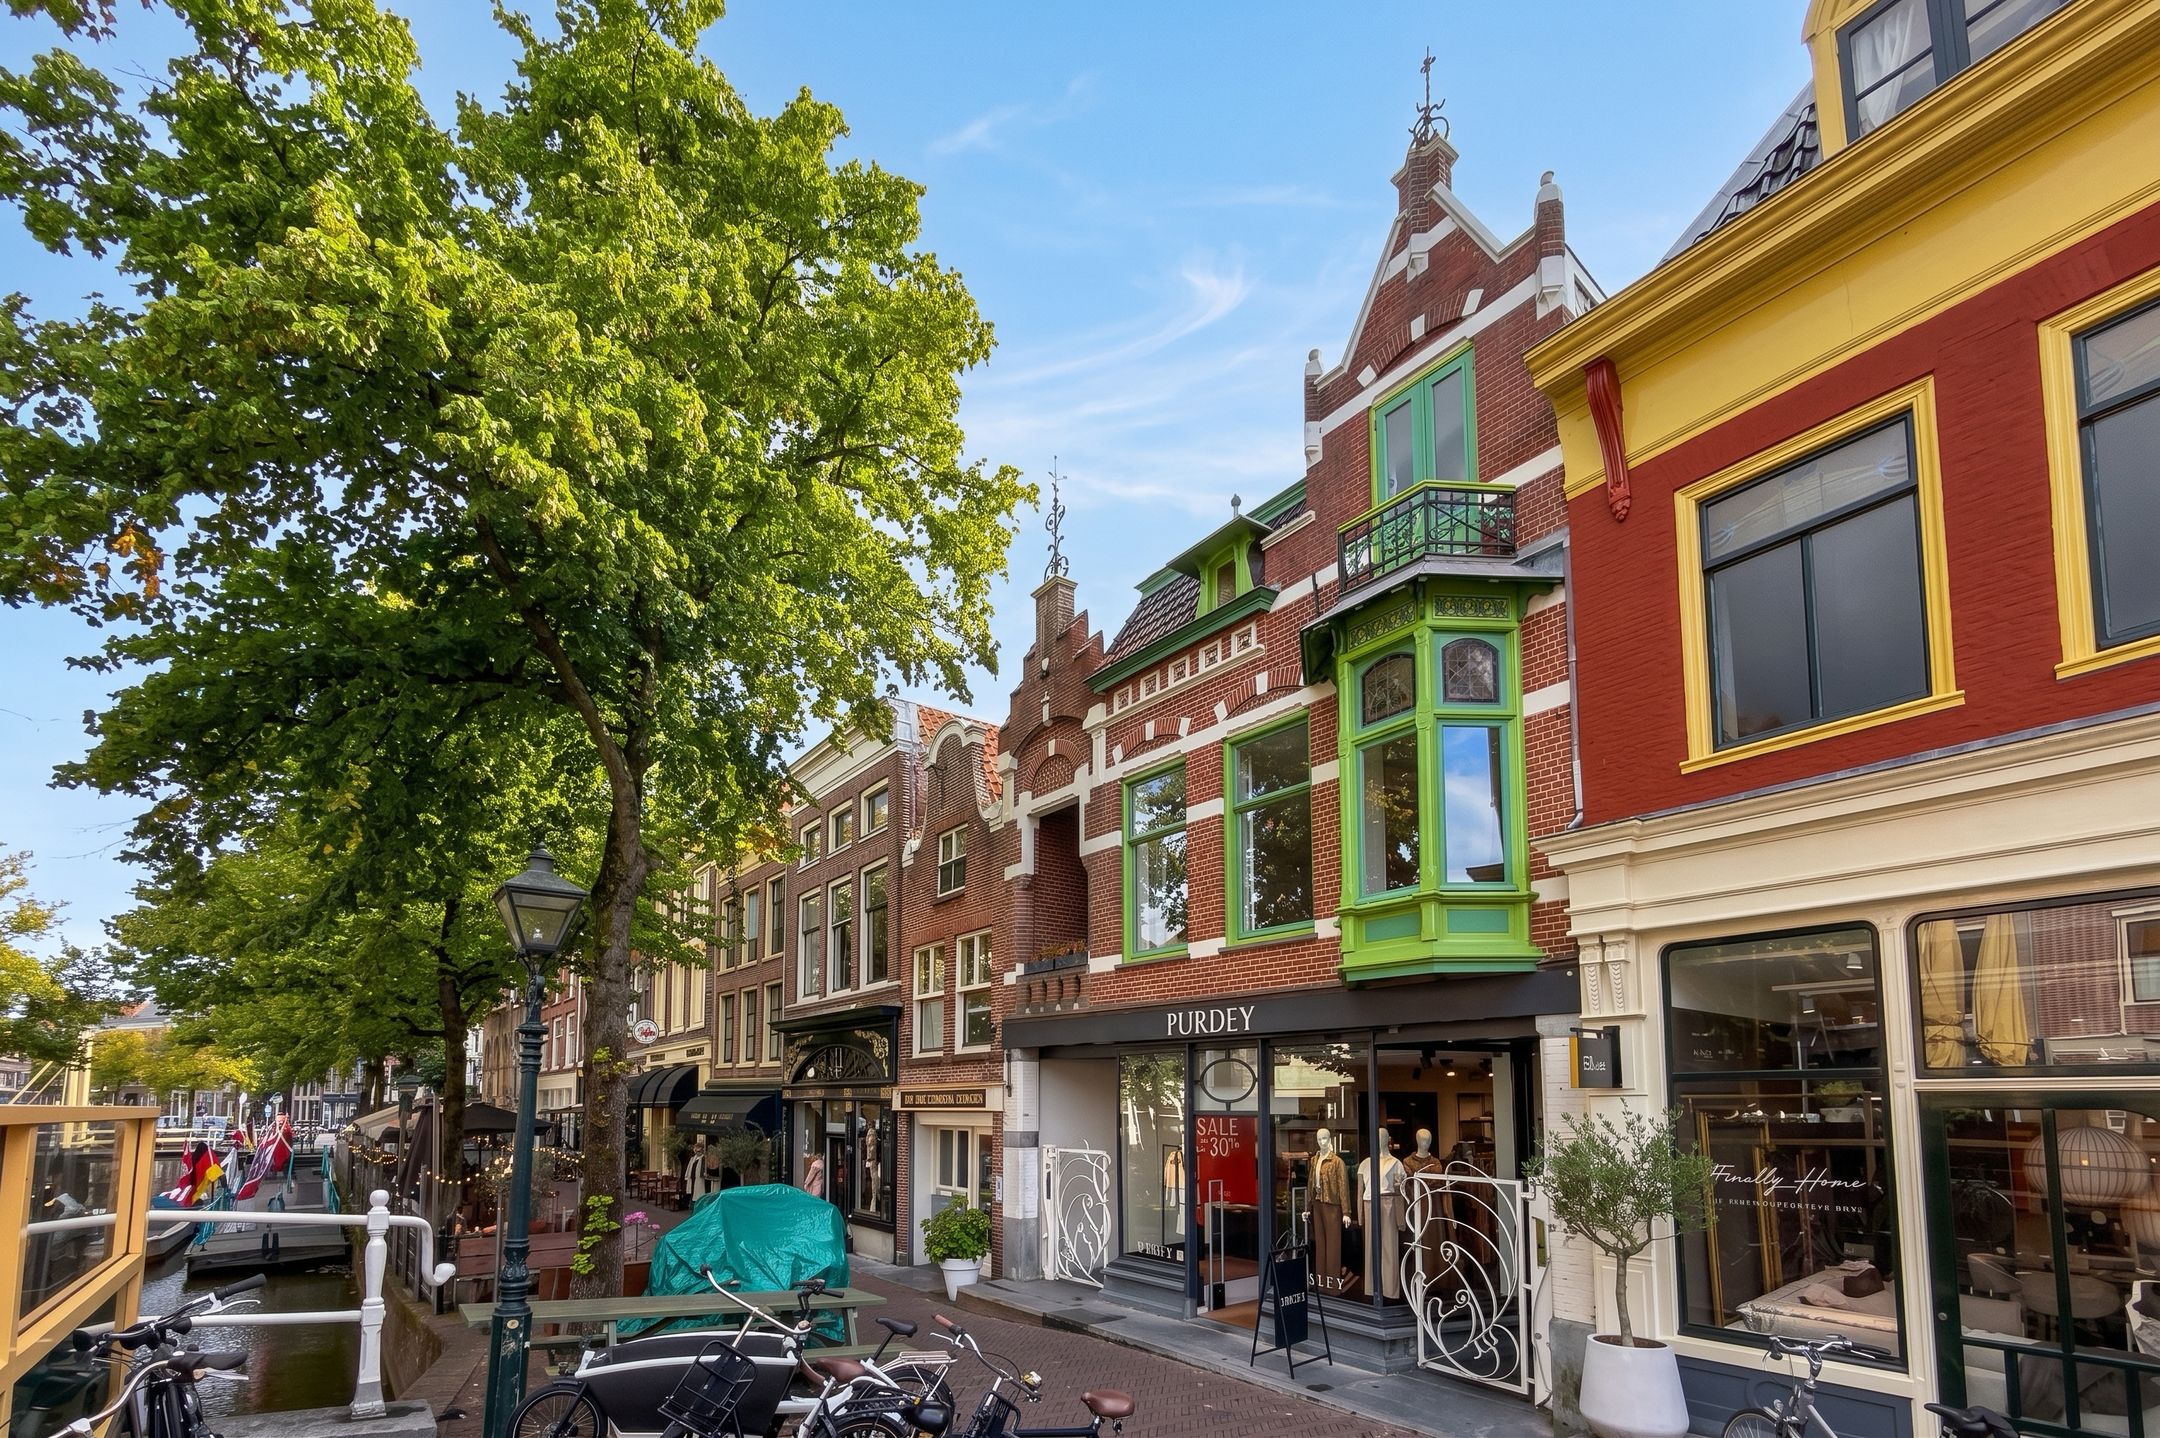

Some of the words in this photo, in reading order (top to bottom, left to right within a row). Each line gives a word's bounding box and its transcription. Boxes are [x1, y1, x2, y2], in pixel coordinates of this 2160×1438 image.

[1167, 1005, 1255, 1036] PURDEY
[1196, 1117, 1239, 1136] SALE
[1710, 1163, 1788, 1197] Finally
[1794, 1167, 1867, 1195] Home
